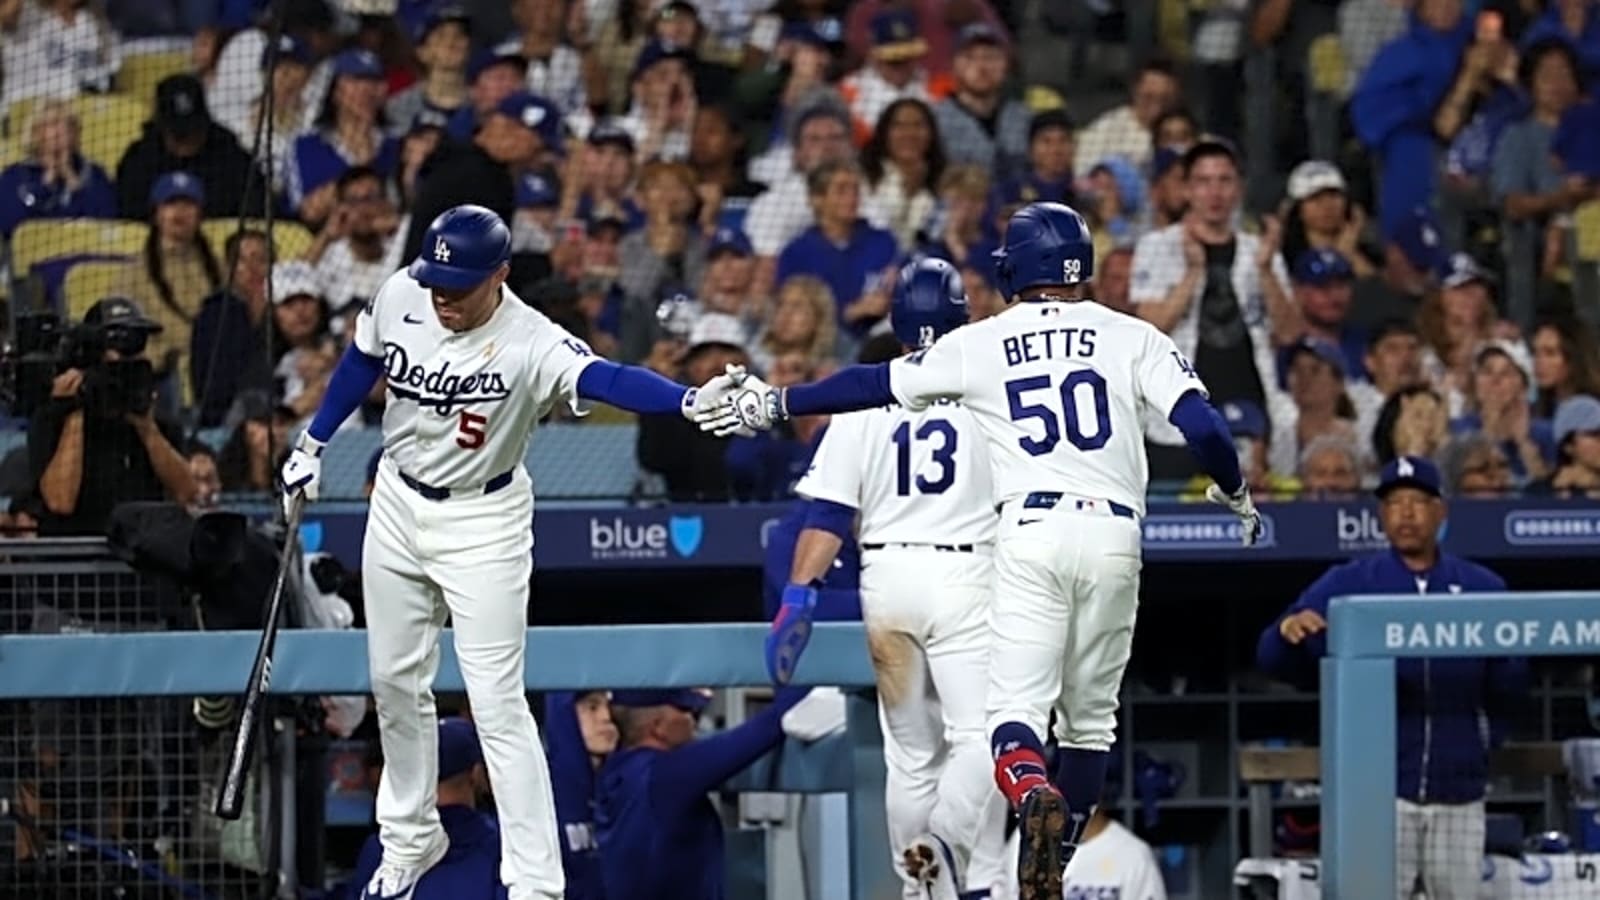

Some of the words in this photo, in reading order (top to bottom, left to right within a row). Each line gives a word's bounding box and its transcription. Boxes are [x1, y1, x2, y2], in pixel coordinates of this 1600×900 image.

[433, 235, 451, 262] LA
[1063, 259, 1081, 273] 50
[1003, 328, 1097, 367] BETTS
[383, 342, 511, 416] Dodgers
[456, 408, 488, 450] 5
[1004, 369, 1113, 457] 50
[892, 419, 958, 497] 13
[590, 517, 668, 549] blue
[1337, 507, 1388, 541] blu
[1385, 622, 1485, 649] BANK
[1494, 620, 1540, 647] OF
[1549, 620, 1600, 646] AM
